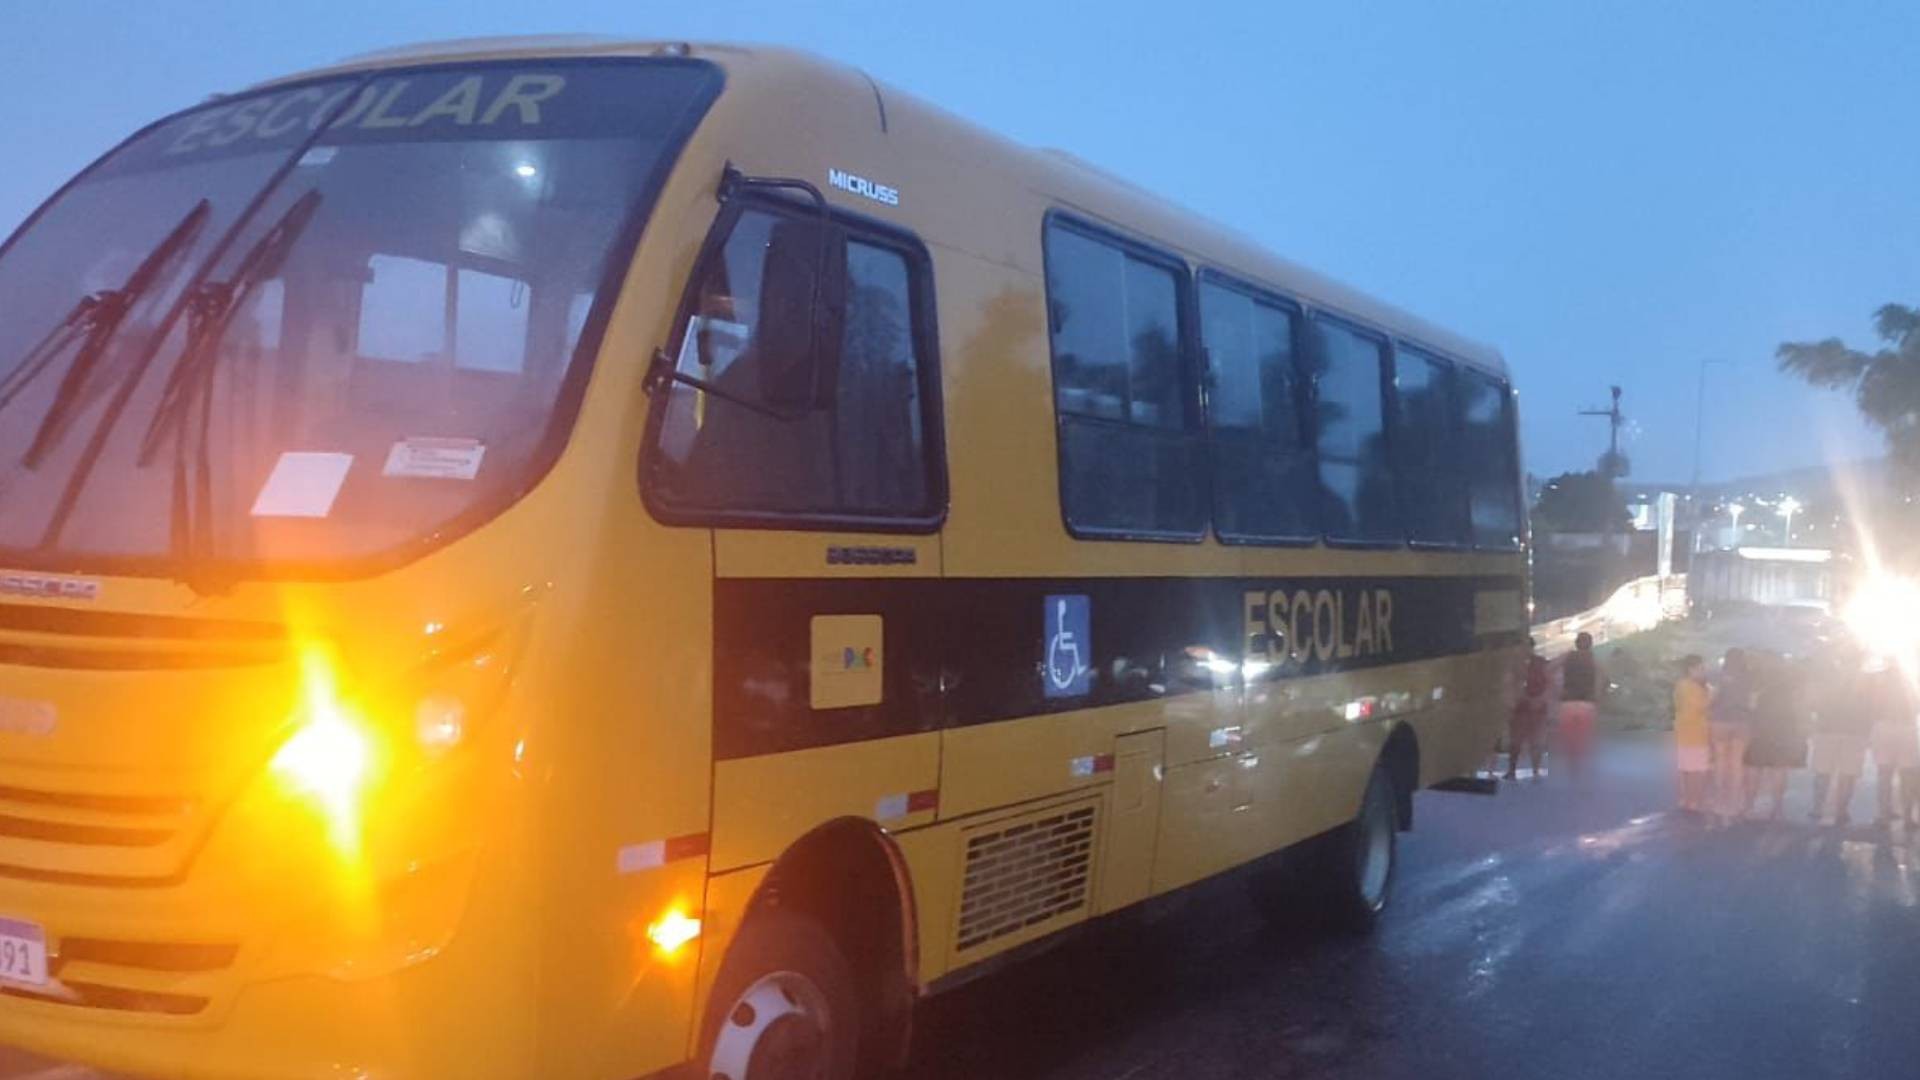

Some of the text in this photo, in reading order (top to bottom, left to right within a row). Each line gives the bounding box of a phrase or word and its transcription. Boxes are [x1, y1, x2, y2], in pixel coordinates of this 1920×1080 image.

[168, 74, 567, 153] ESCOLAR
[829, 168, 898, 205] MICRUSS
[1243, 588, 1394, 665] ESCOLAR
